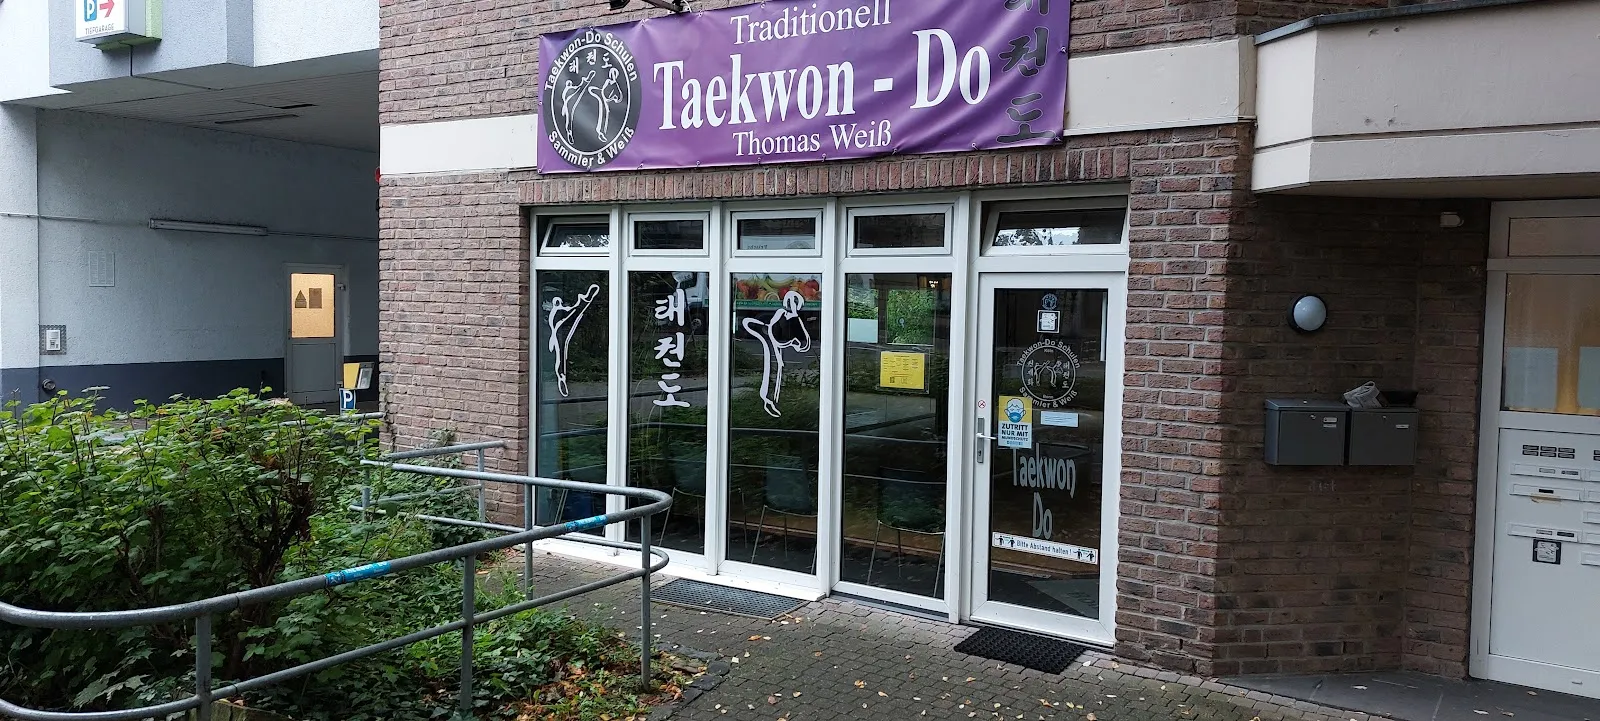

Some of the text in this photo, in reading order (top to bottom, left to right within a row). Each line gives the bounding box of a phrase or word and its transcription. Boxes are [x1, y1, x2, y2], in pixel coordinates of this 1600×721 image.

[86, 0, 95, 19] P
[730, 0, 892, 45] Traditionell
[544, 30, 638, 91] Taekwon-Do Schulen
[653, 28, 991, 130] Taekwon - Do
[548, 126, 635, 167] Sammler & Weiß
[732, 120, 892, 156] Thomas Weiß
[1016, 338, 1081, 369] Taekwon-Do Schulen
[343, 390, 354, 409] P
[1052, 400, 1059, 408] &
[1058, 389, 1078, 406] Weiß
[1001, 423, 1029, 431] ZUTRITT
[1010, 442, 1077, 499] Taekwon
[1032, 491, 1053, 540] Do
[1016, 539, 1029, 547] Bitte
[1029, 542, 1051, 552] Abstand
